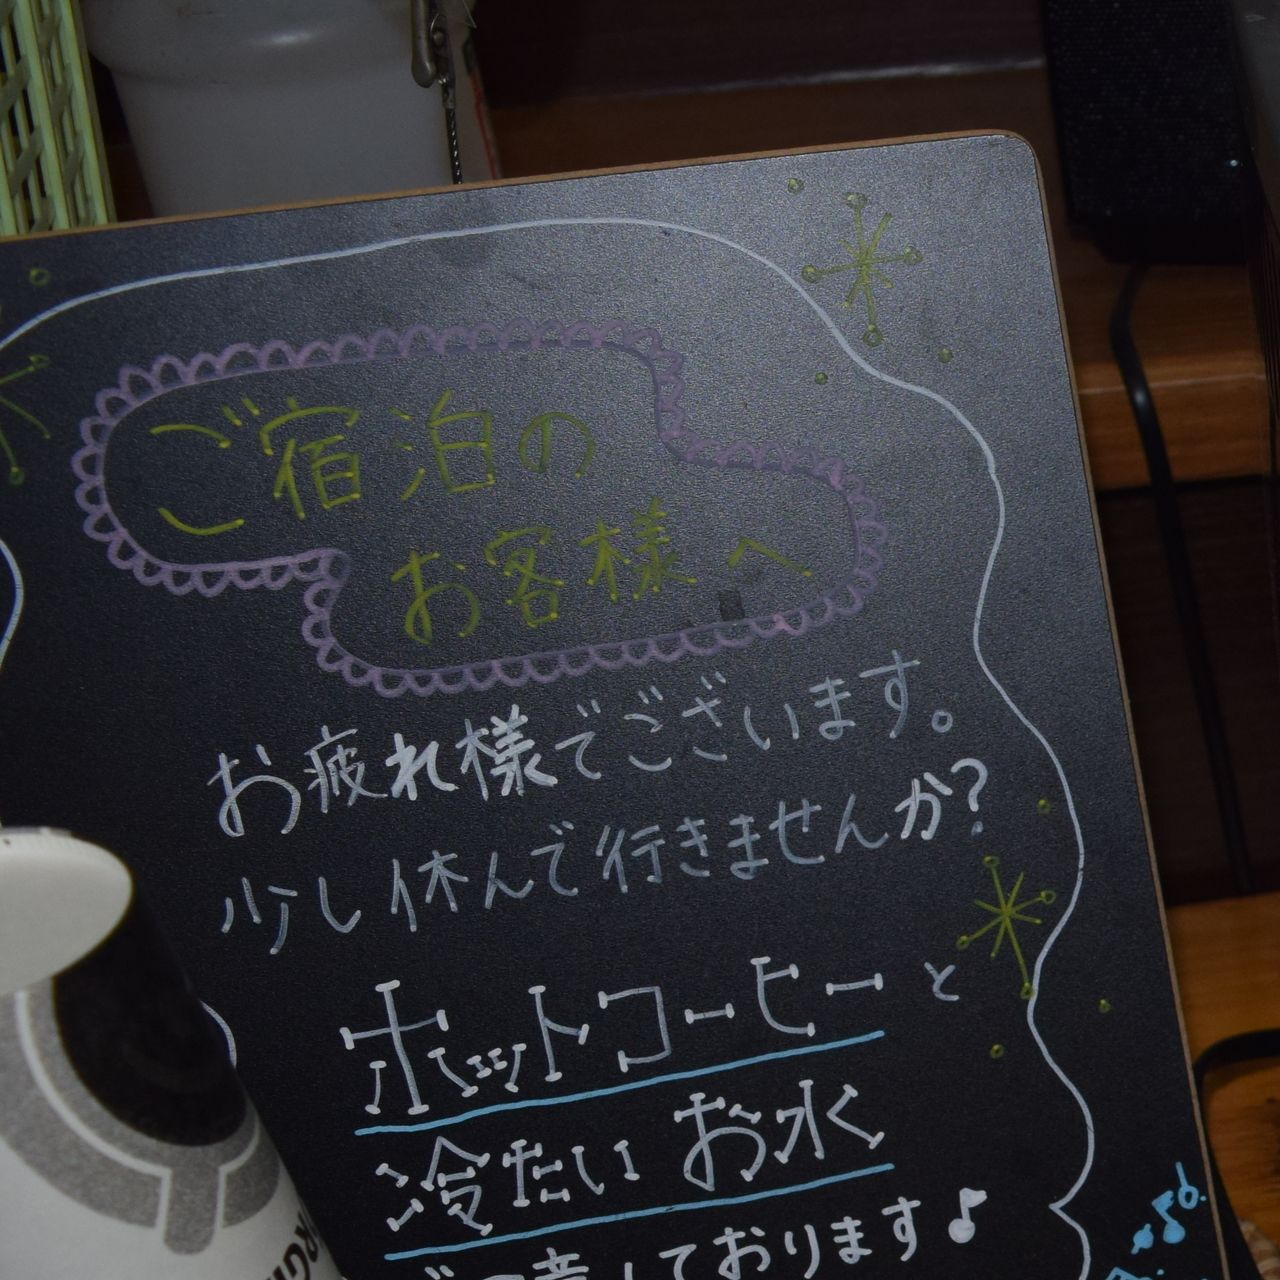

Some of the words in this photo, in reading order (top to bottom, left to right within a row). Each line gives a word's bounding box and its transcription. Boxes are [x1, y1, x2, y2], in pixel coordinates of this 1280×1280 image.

[150, 391, 595, 535] ご宿泊の
[392, 497, 811, 645] お客様へ
[208, 650, 955, 838] お疲れ様でございます。
